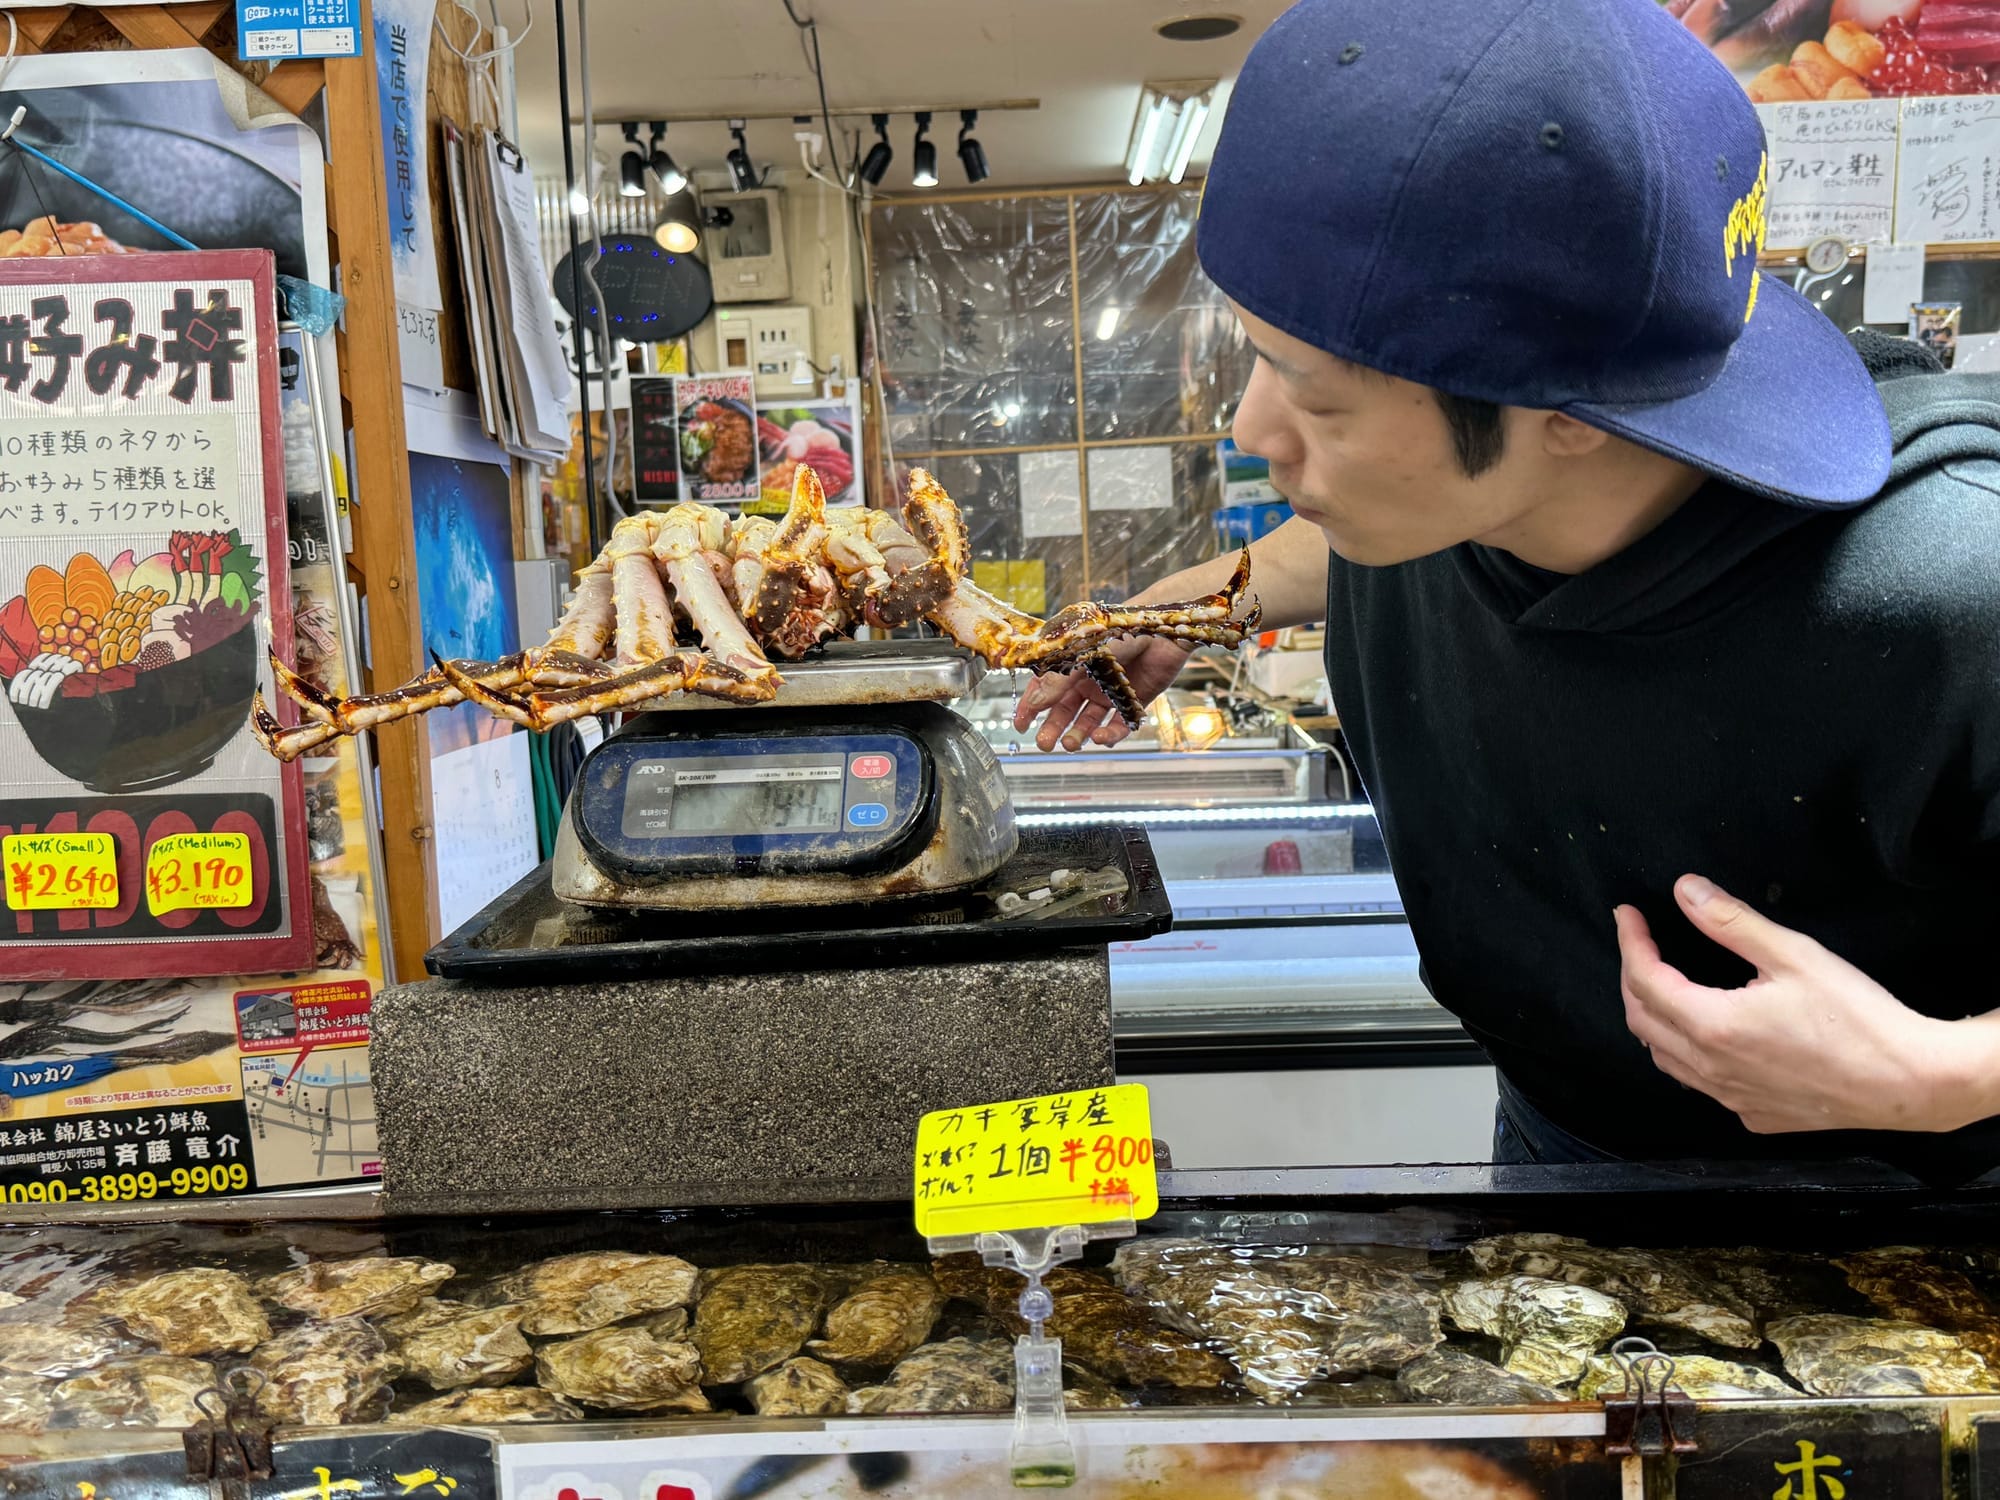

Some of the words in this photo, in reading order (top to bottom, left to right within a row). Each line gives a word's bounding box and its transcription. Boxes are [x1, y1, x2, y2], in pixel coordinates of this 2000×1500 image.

[273, 8, 299, 17] トラベル
[308, 6, 344, 14] クーポン
[308, 15, 345, 25] 使えます
[391, 24, 415, 253] 当店で使用して
[857, 810, 880, 820] ゼロ
[12, 838, 55, 855] 小サイズ
[12, 1064, 75, 1088] ハッカク
[54, 1110, 211, 1144] 錦屋さいとう鮮魚
